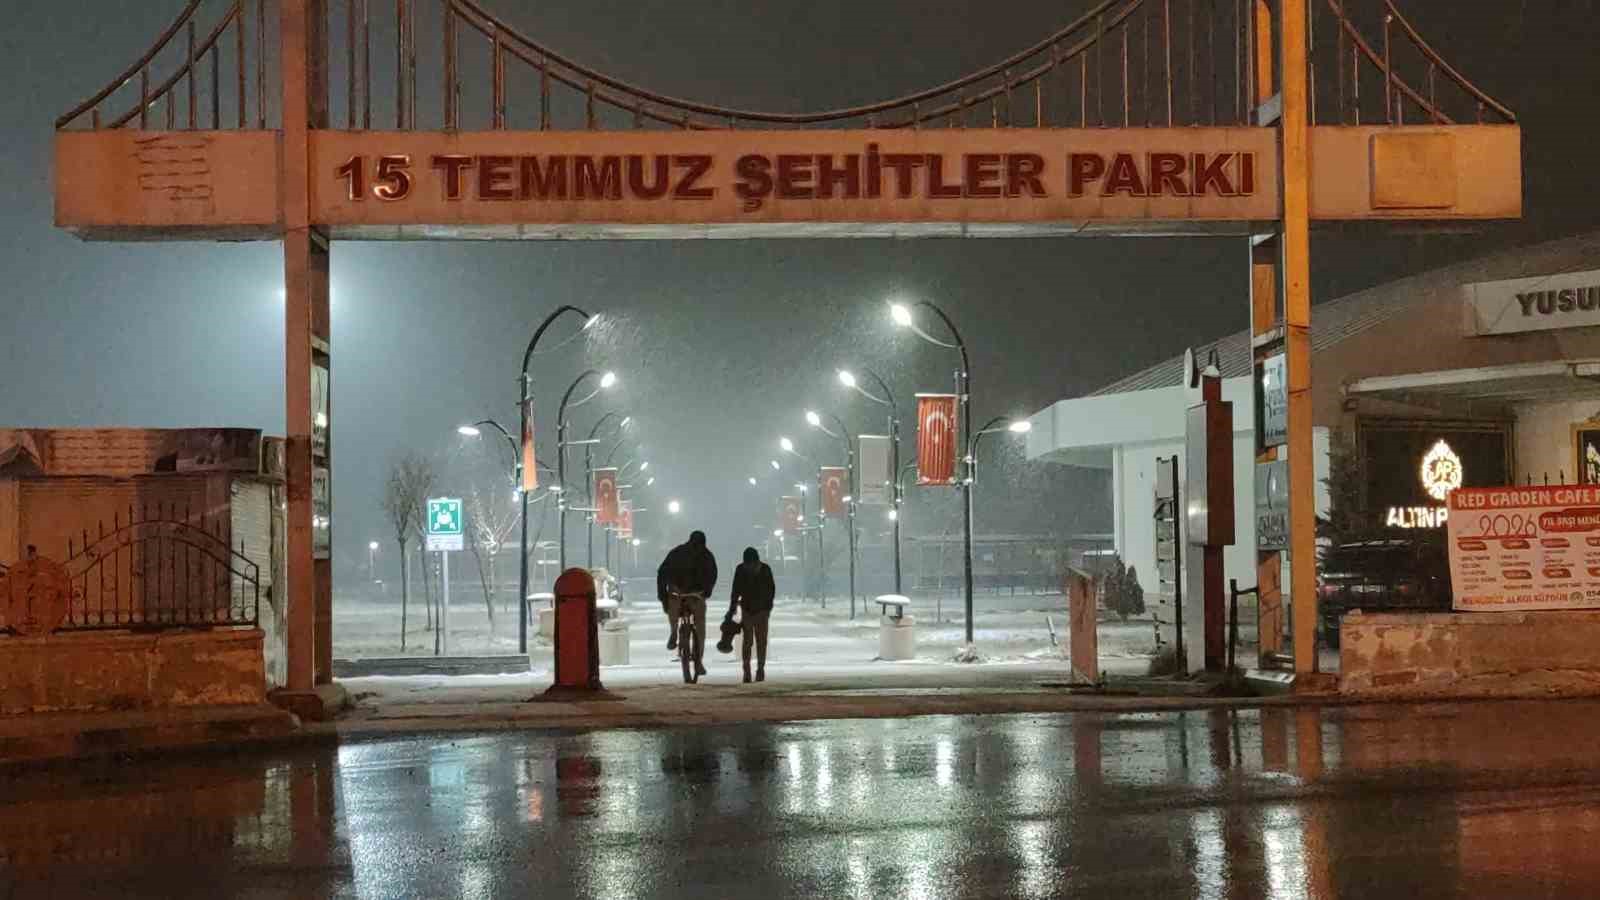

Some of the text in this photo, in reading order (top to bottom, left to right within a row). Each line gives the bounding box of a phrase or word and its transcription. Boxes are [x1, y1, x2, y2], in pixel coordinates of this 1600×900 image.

[336, 142, 1255, 213] 15 TEMMUZ ŞEHİTLER PARKI
[1515, 286, 1600, 317] YUSU
[1457, 493, 1486, 507] RED
[1490, 491, 1551, 506] GARDEN
[1555, 489, 1590, 503] CAFE
